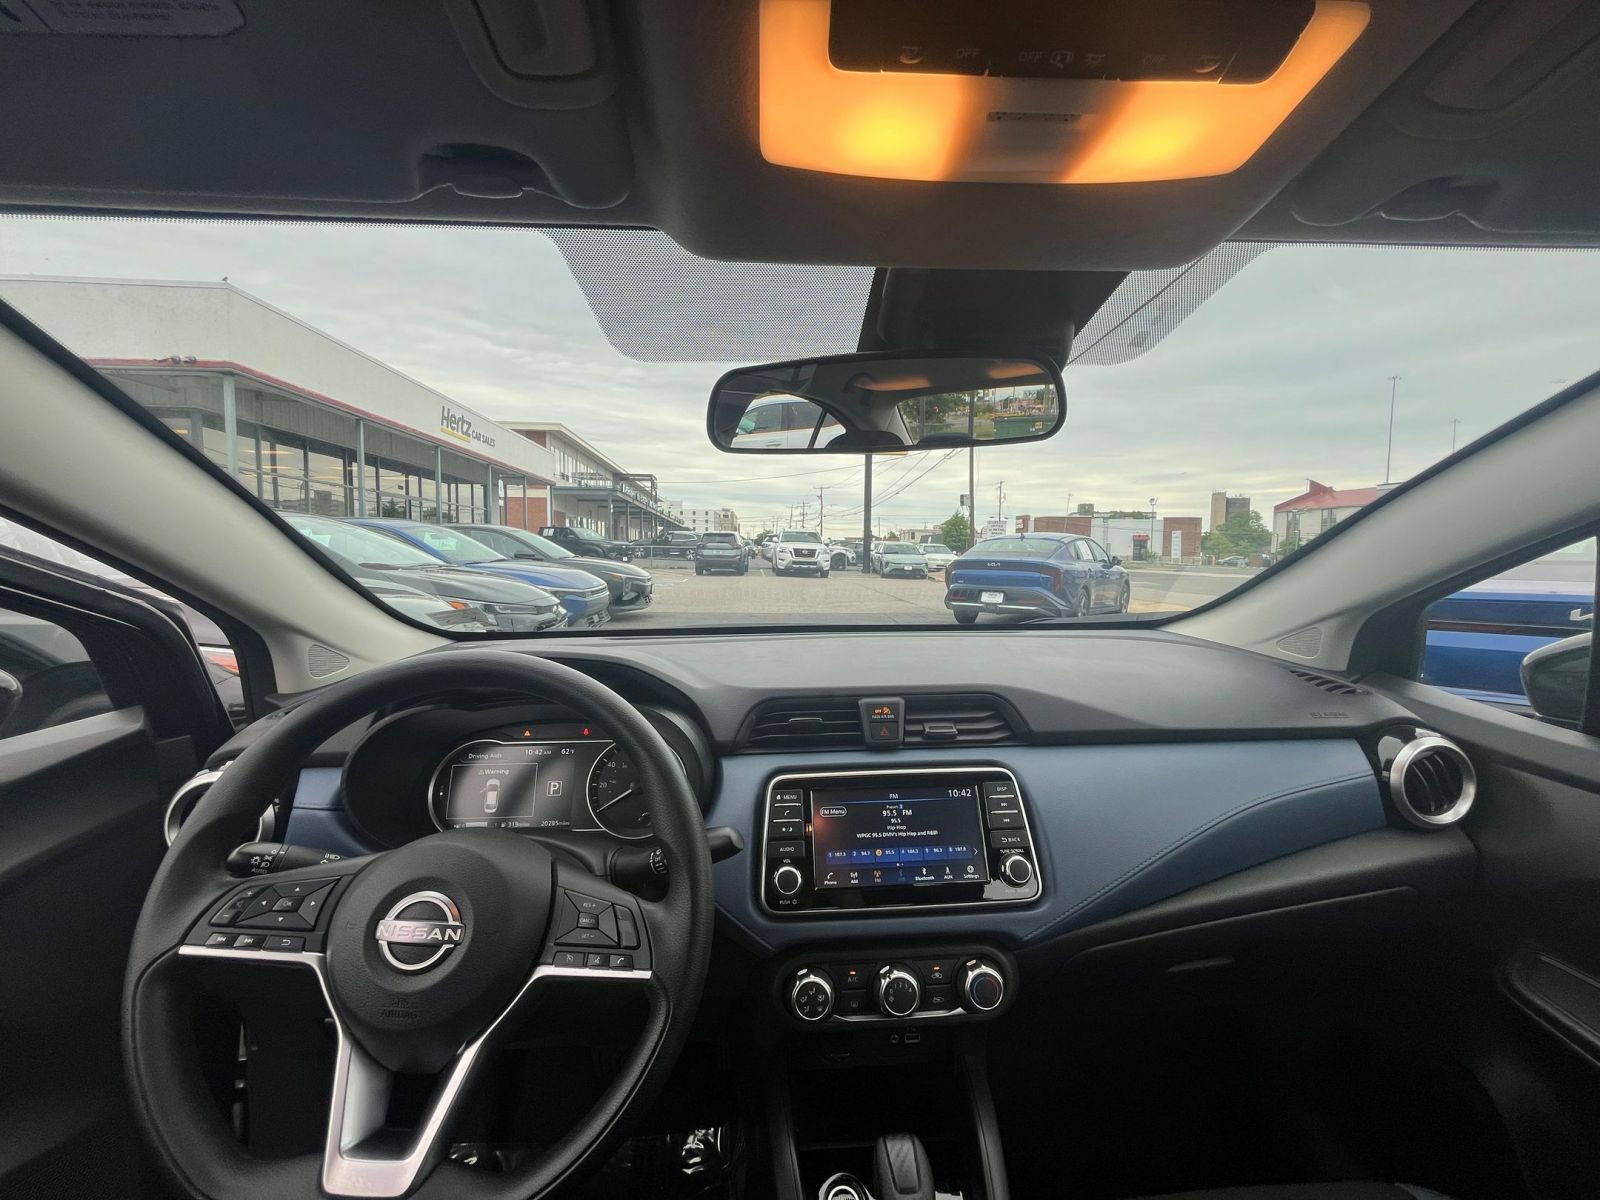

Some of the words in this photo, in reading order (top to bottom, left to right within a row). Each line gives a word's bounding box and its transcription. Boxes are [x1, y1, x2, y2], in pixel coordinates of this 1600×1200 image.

[440, 405, 472, 437] Hertz
[471, 430, 481, 442] CAR
[481, 434, 496, 447] SALES
[550, 782, 560, 795] P
[948, 788, 972, 798] 10:42
[377, 924, 462, 941] NISSAN
